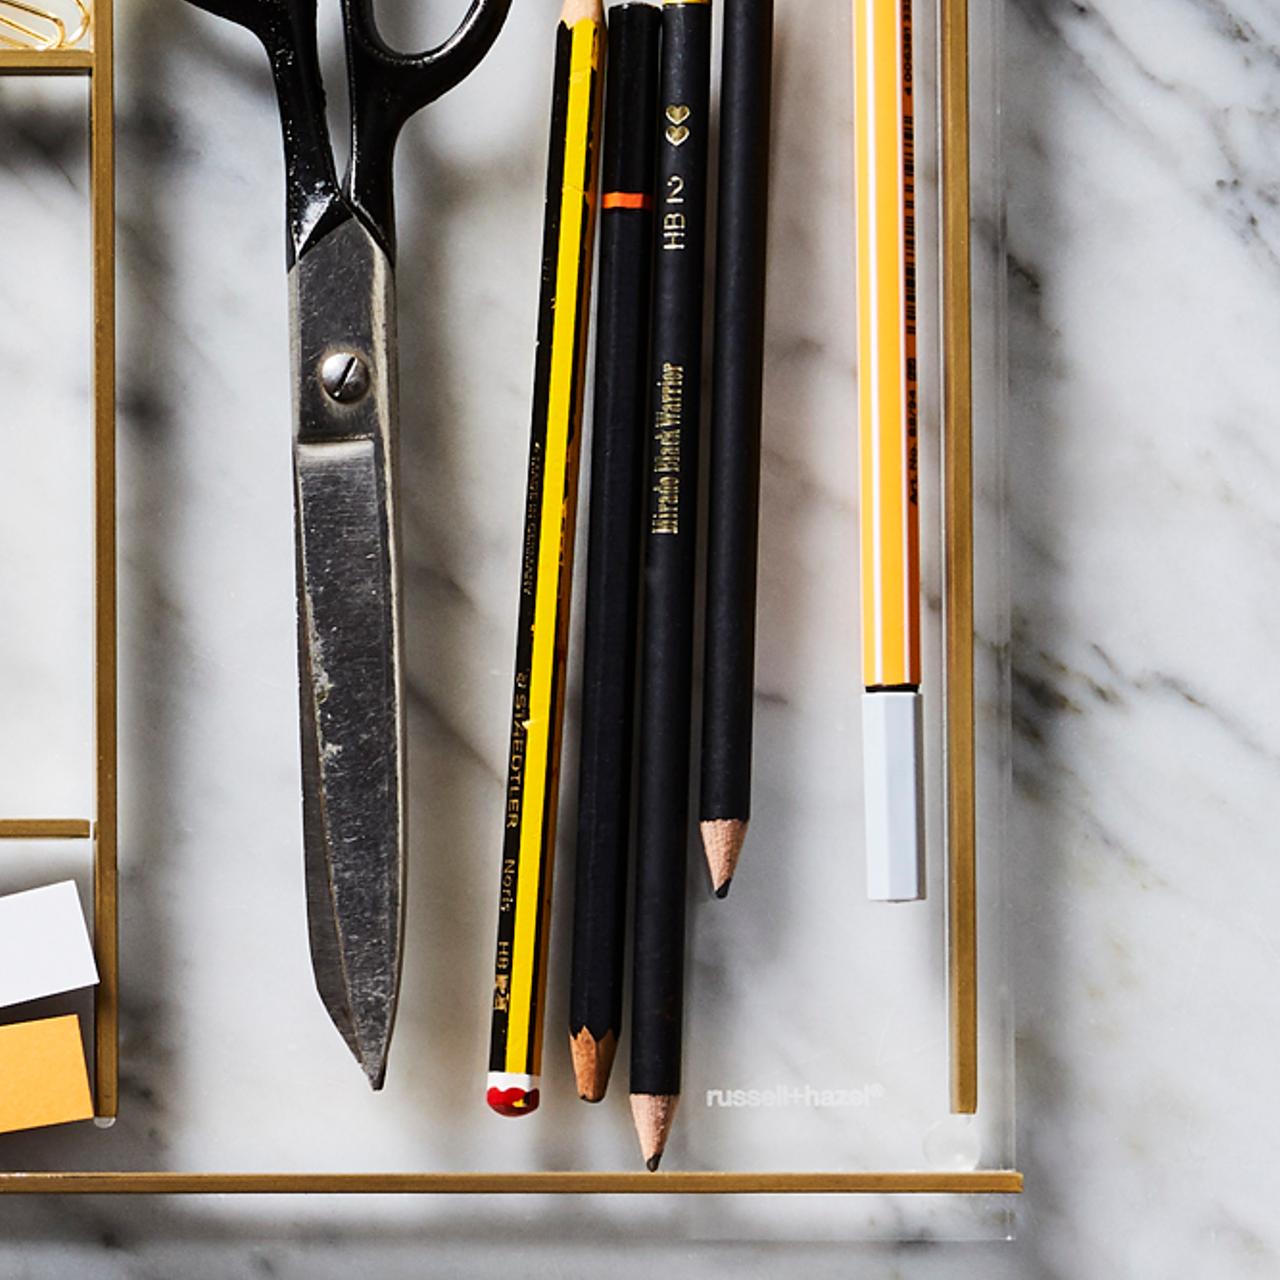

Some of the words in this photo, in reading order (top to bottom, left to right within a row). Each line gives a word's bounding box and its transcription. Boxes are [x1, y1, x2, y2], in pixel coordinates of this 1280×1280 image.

[666, 175, 684, 204] 2
[663, 213, 685, 250] HB
[654, 362, 684, 428] Warrior
